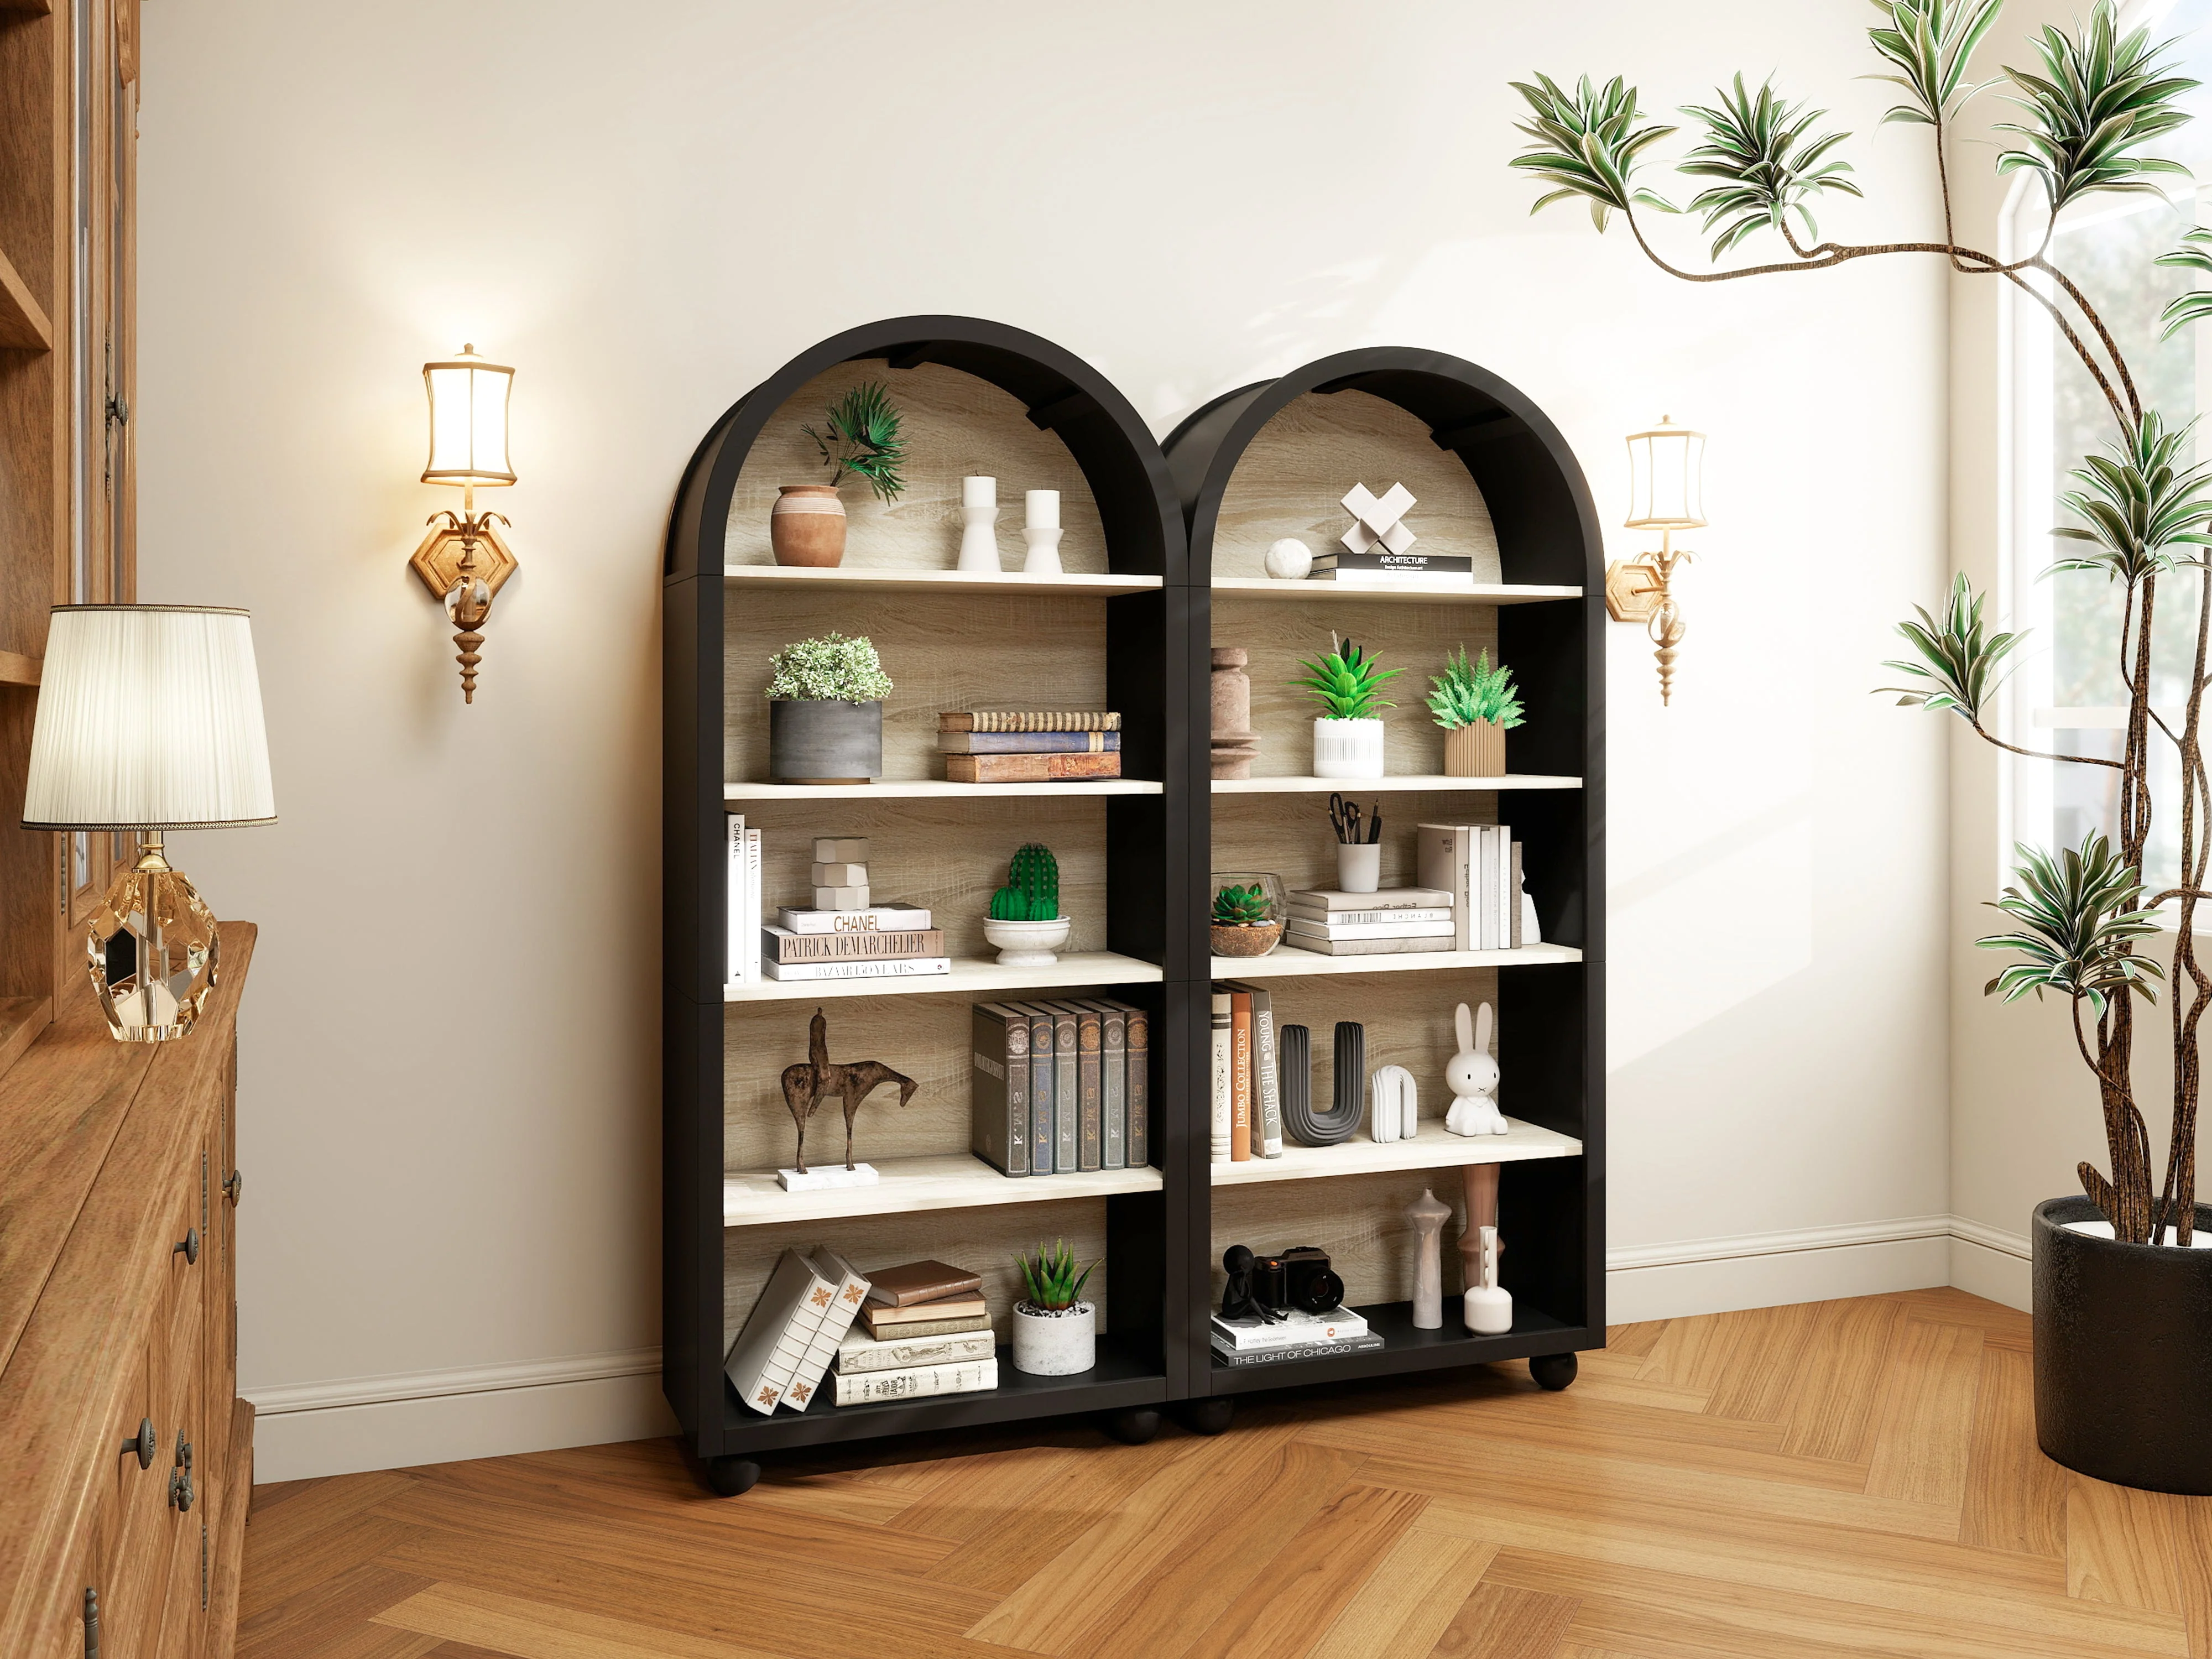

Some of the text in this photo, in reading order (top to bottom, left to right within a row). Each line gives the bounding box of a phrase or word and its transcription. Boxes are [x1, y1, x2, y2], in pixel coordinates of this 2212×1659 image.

[1380, 555, 1428, 564] ARCHITECTURE
[834, 915, 880, 932] CHANEL
[783, 937, 832, 958] PATRICK
[836, 933, 925, 956] DEMARCHELIER
[1236, 1029, 1248, 1128] JUMBO COLLECTION
[1259, 1011, 1277, 1126] YOUNG THE SHACK
[1234, 1344, 1352, 1365] THE LIGHT OF CHICAGO
